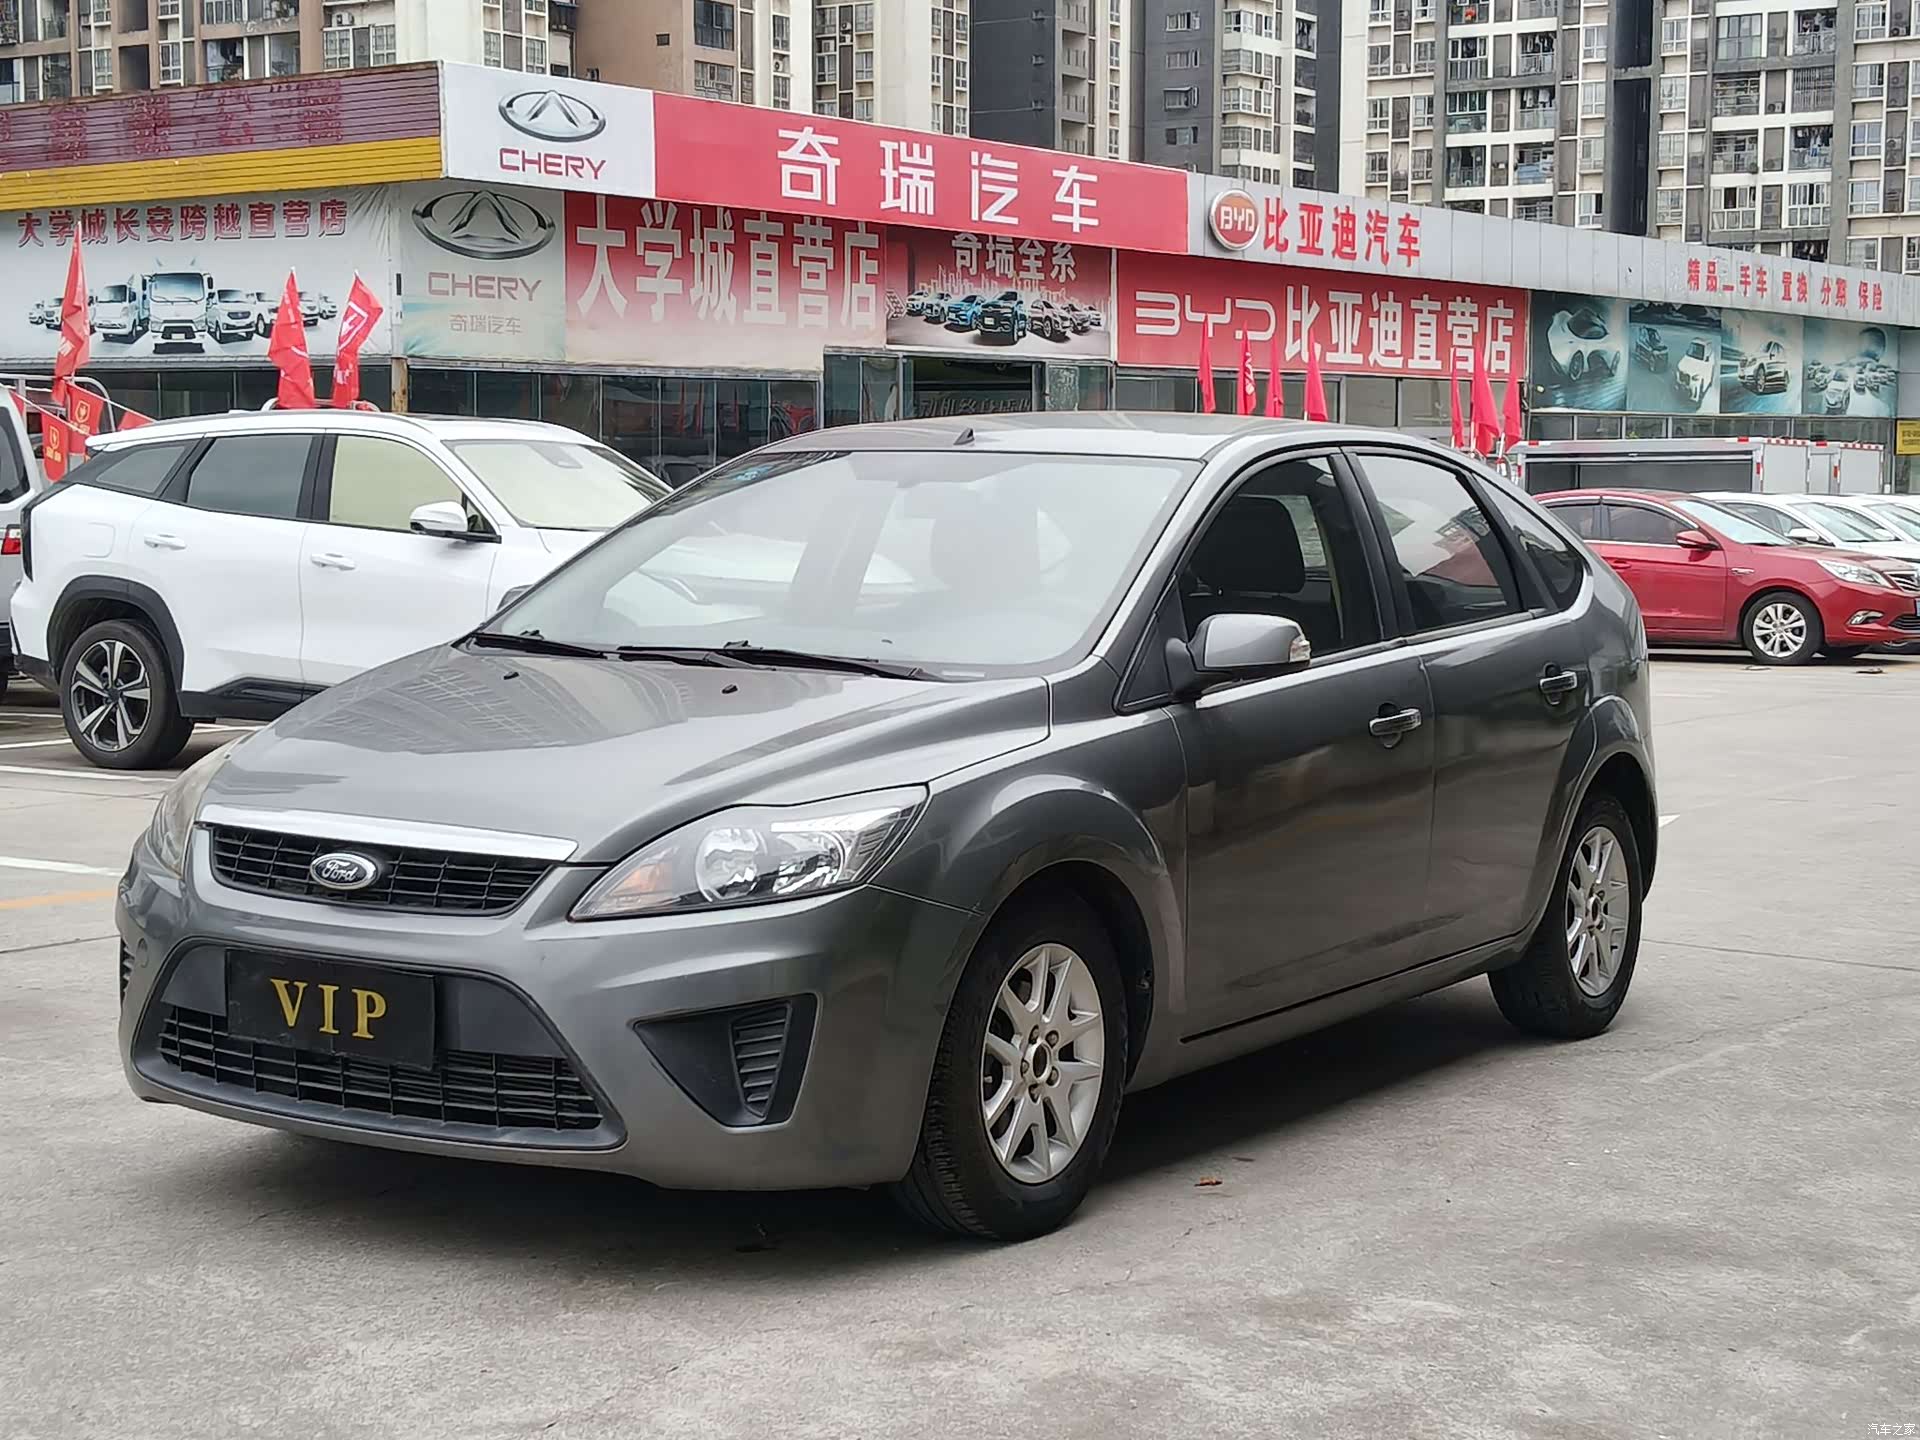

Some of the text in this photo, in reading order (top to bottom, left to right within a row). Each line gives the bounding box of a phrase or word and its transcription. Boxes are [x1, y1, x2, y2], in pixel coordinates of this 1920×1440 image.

[499, 147, 607, 181] CHERY
[777, 126, 1100, 233] 奇瑞汽车
[18, 199, 349, 248] 大学城长安跨越直营店
[1219, 204, 1256, 233] BYD
[1263, 197, 1421, 268] 比亚迪汽车
[575, 194, 880, 331] 大学城直营店
[951, 232, 1077, 284] 奇瑞全系
[427, 271, 543, 302] CHERY
[1781, 271, 1809, 304] 置换
[1820, 276, 1848, 308] 分期
[1858, 280, 1884, 312] 保险
[450, 314, 522, 336] 奇瑞汽车
[1135, 290, 1277, 341] BYD
[1284, 285, 1515, 375] 比亚迪直营店
[320, 858, 360, 883] Ford
[270, 977, 387, 1040] VIP
